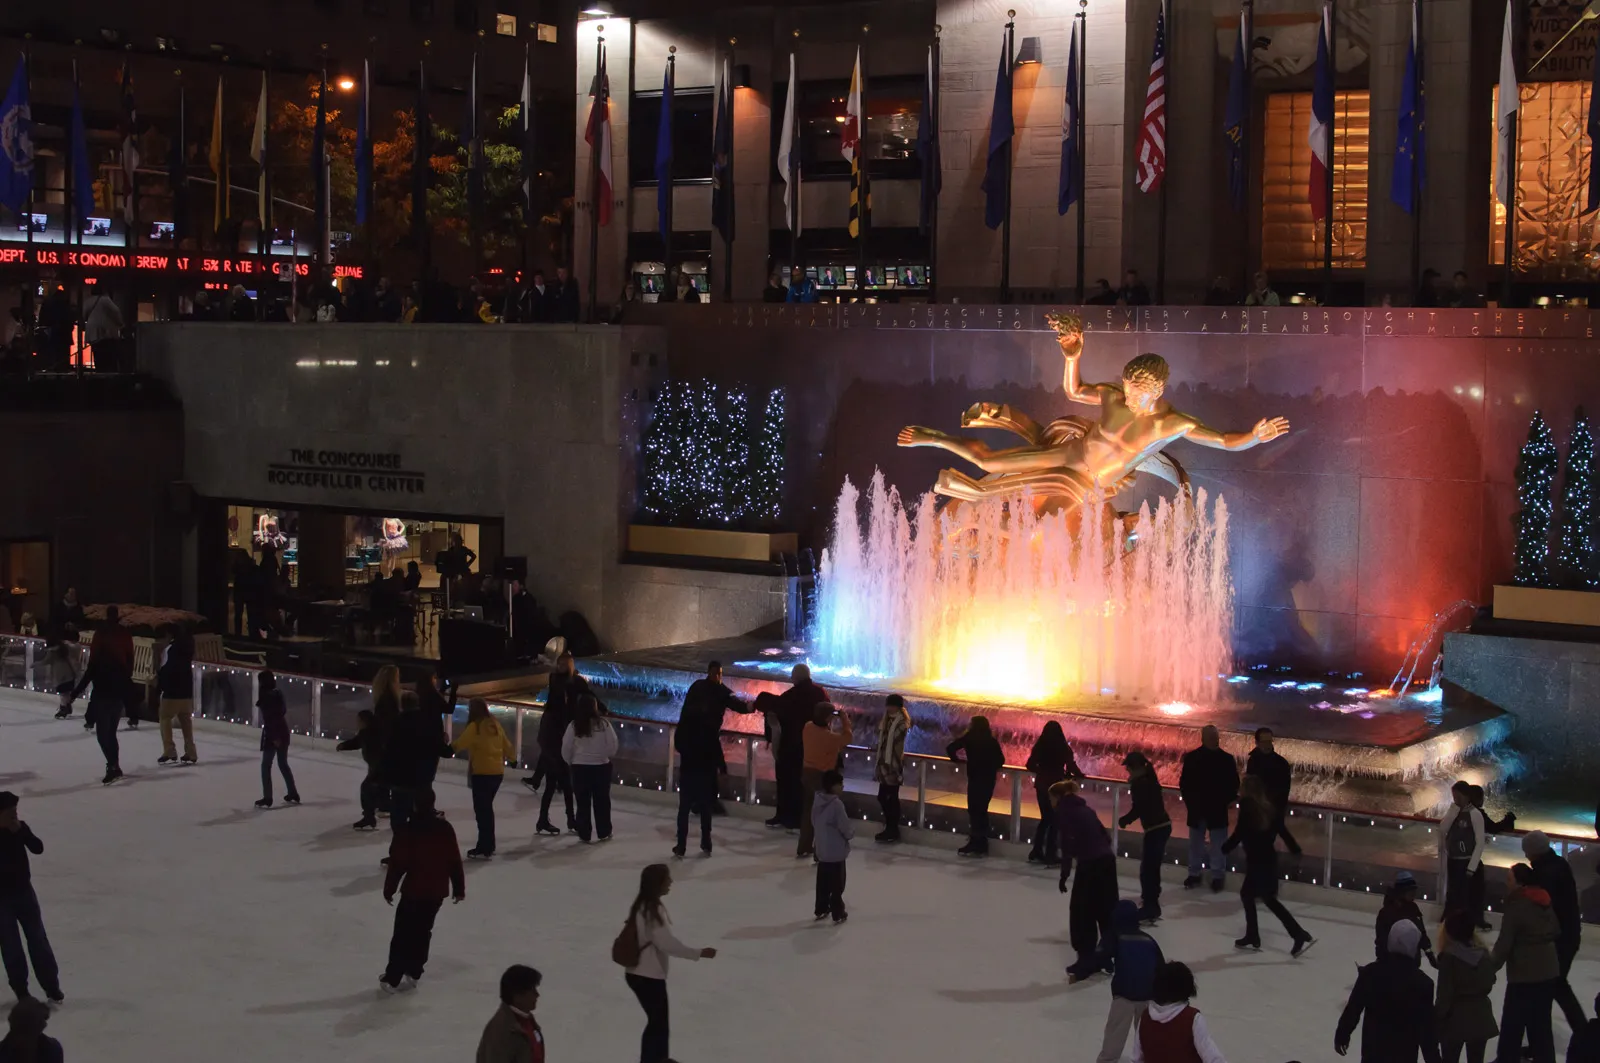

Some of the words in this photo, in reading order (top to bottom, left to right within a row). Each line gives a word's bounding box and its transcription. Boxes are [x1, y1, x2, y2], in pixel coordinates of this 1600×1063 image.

[37, 250, 60, 264] U.S.
[1106, 309, 1189, 319] EVERY
[1221, 310, 1269, 320] ART
[1473, 312, 1524, 323] THE
[997, 320, 1021, 330] TO
[1240, 323, 1329, 334] MEANS
[1365, 325, 1393, 335] TO
[1428, 326, 1548, 337] MIGHTY
[291, 449, 314, 464] THE
[318, 450, 401, 469] CONCOURSE
[268, 470, 362, 490] ROCKEFELLER
[368, 476, 425, 493] CENTER
